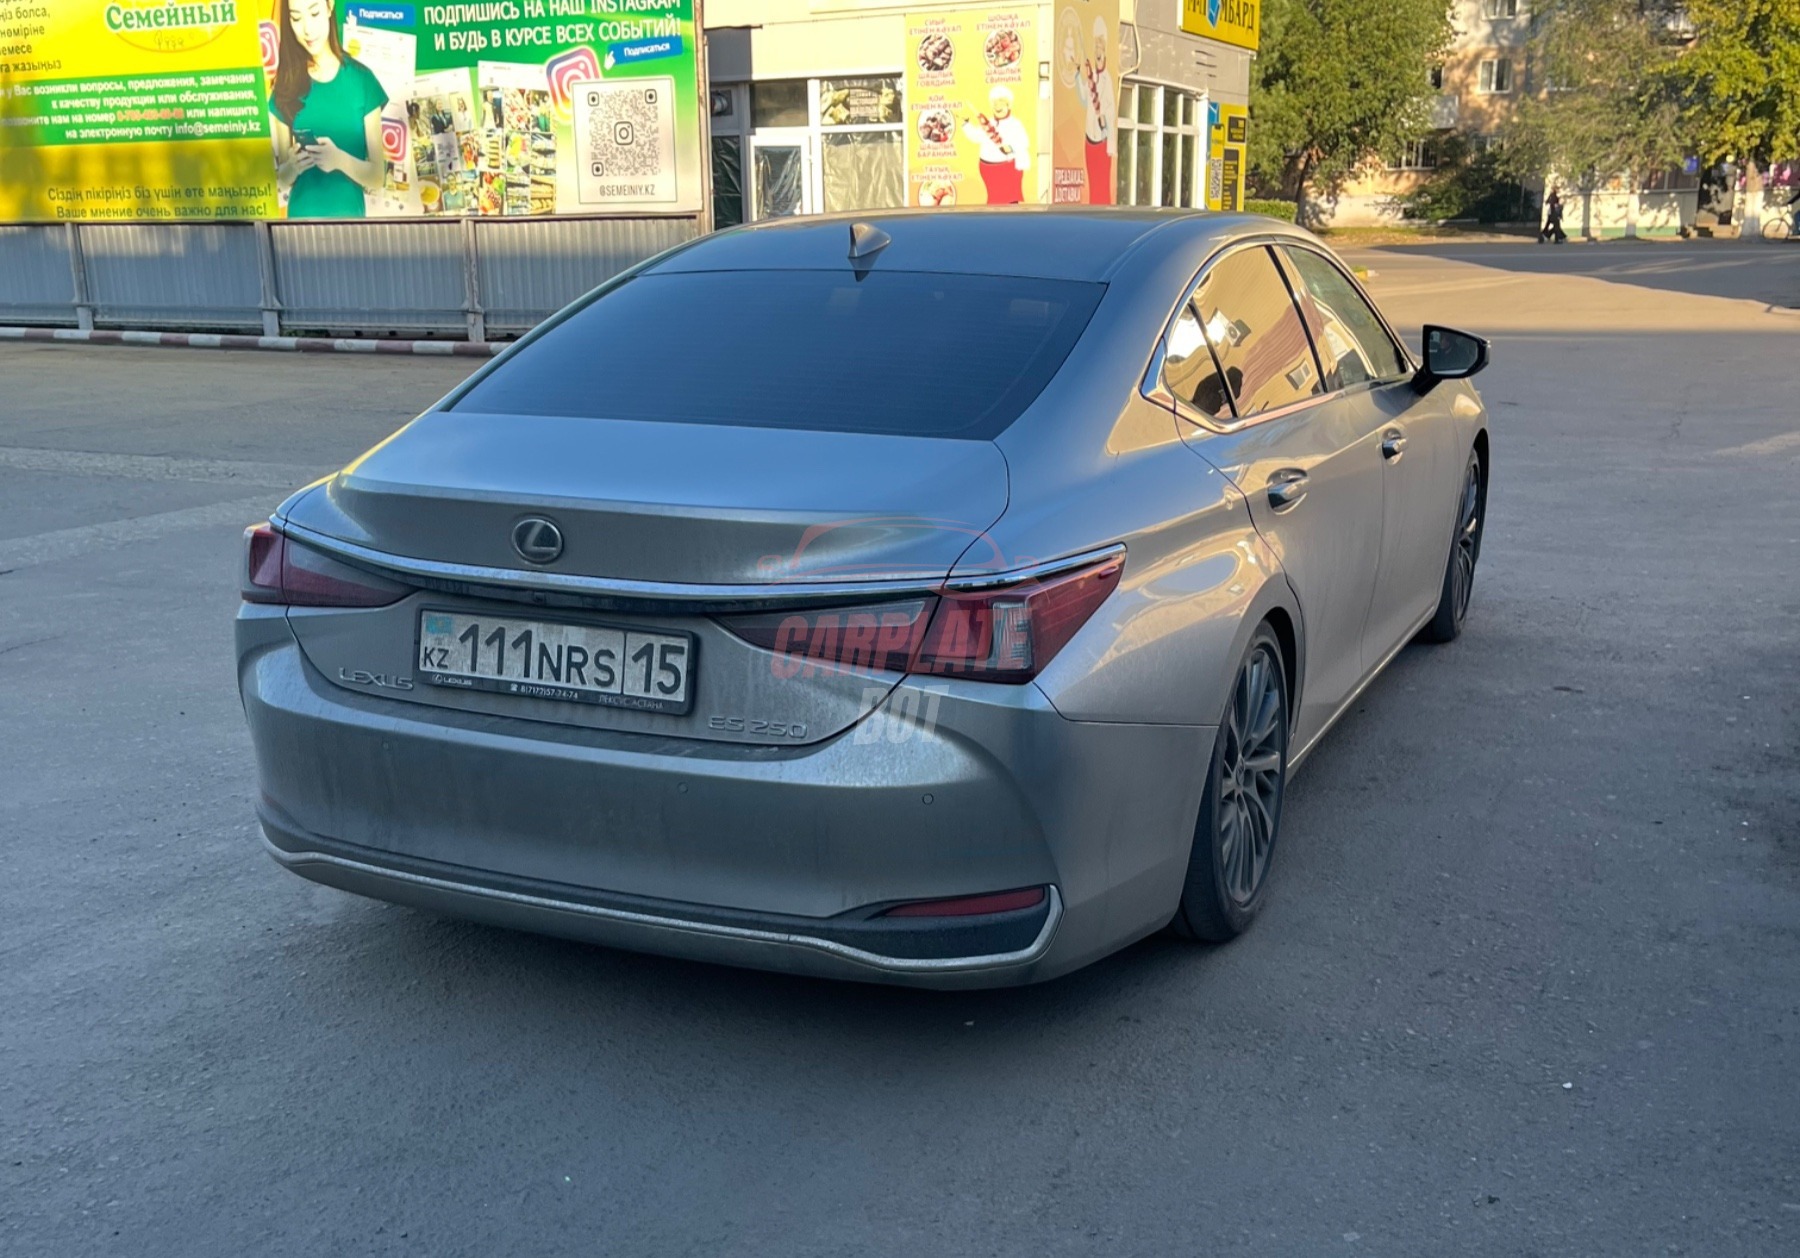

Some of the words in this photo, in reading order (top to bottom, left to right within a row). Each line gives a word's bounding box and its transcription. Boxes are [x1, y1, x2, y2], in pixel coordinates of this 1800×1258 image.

[106, 0, 236, 30] Семейный
[359, 8, 404, 20] Подписаться
[424, 1, 520, 27] ПОДПИШИСЬ
[524, 0, 546, 18] НА
[550, 0, 585, 16] НАШ
[591, 0, 681, 14] INSTAGRAM
[434, 33, 446, 51] И
[449, 30, 488, 52] БУДЬ
[491, 29, 502, 47] В
[506, 26, 552, 46] КУРСЕ
[556, 23, 595, 43] ВСЕХ
[598, 13, 681, 41] СОБЫТИЙ!
[0, 44, 32, 56] емесе
[13, 60, 62, 73] жазыңыз
[14, 84, 32, 96] Вас
[200, 73, 256, 86] замечания
[85, 111, 116, 125] номер
[207, 106, 259, 117] напишите
[80, 127, 143, 140] электронную
[144, 125, 173, 138] почту
[48, 188, 83, 201] Сіздің
[134, 186, 151, 199] біз
[208, 184, 272, 199] маңызды!
[599, 184, 656, 197] @SEMEINIY.KZ
[57, 206, 87, 218] Ваше
[90, 206, 133, 218] мнение
[136, 204, 171, 218] очень
[174, 203, 211, 217] важно
[215, 204, 239, 217] для
[243, 203, 268, 216] нас!
[423, 646, 449, 669] KZ
[631, 642, 686, 695] 15
[339, 667, 414, 691] LEXUS
[709, 716, 745, 732] ES
[749, 720, 808, 739] 250
